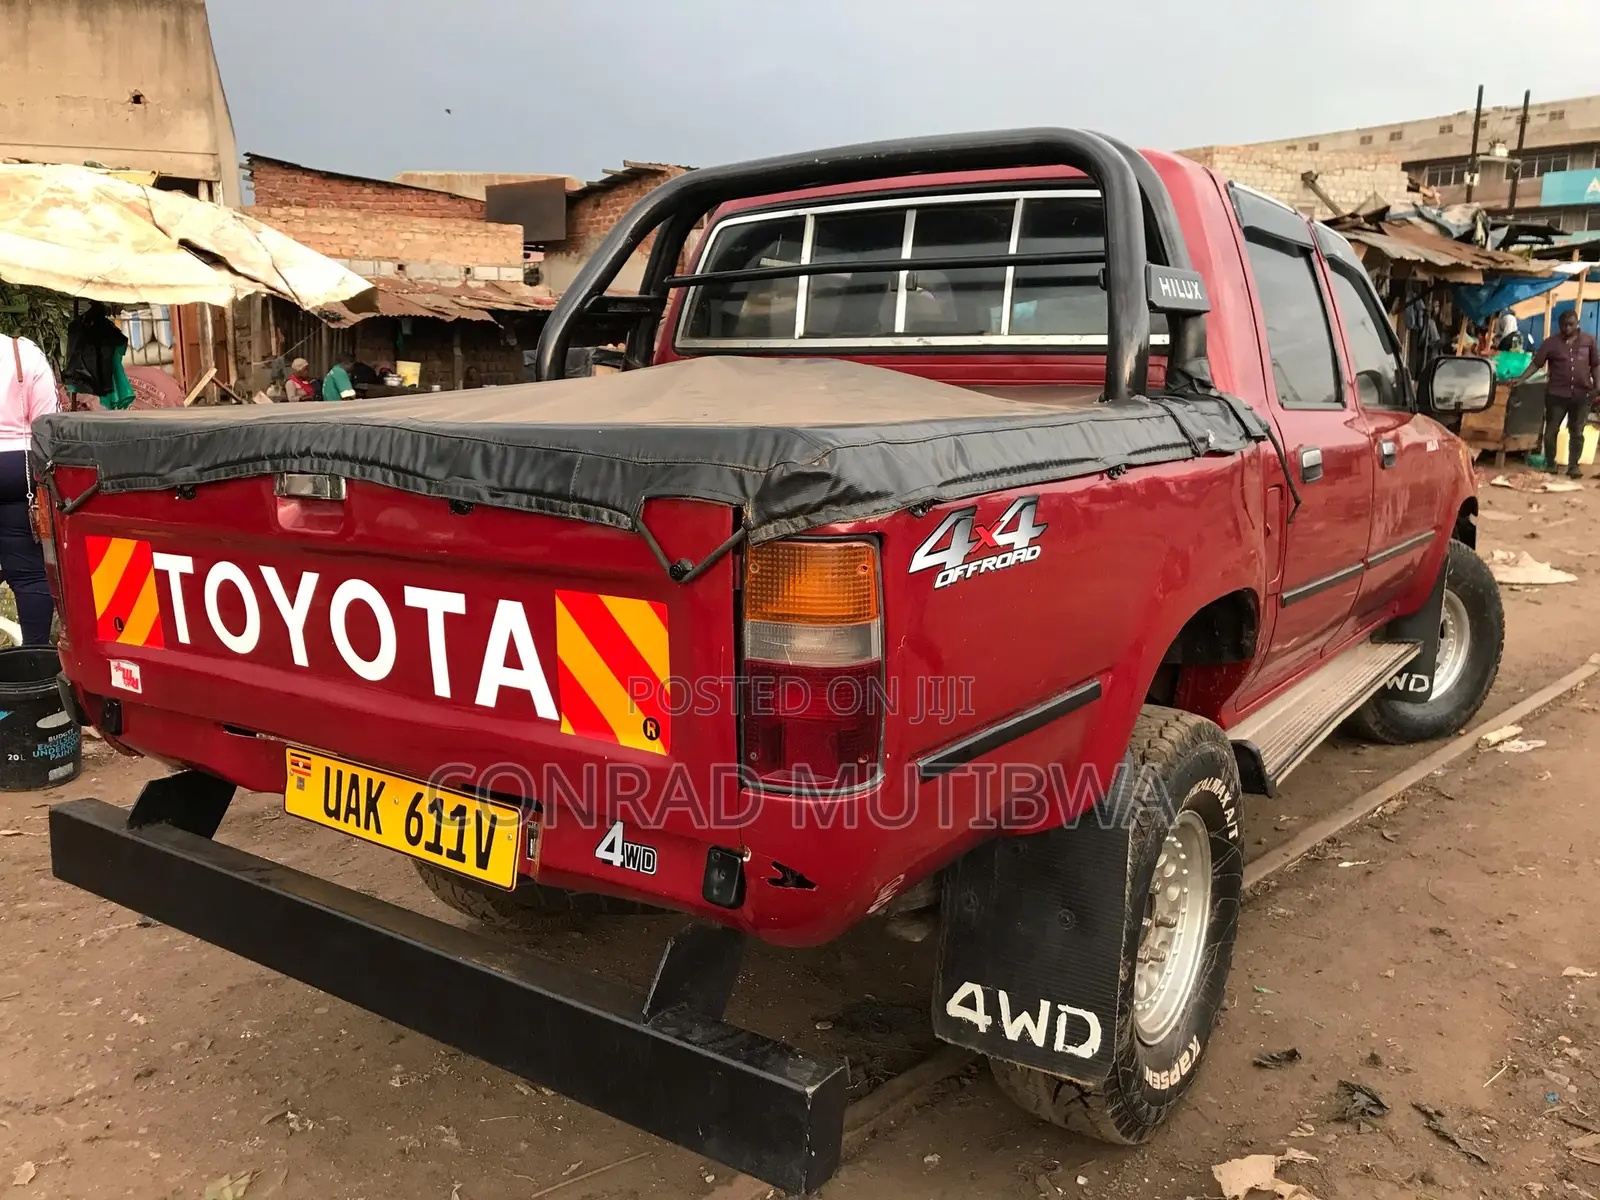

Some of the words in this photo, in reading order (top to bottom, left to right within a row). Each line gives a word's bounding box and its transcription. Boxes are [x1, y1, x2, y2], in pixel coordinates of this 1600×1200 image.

[1158, 277, 1203, 300] HILUX
[934, 545, 1041, 589] OFFROAD
[153, 551, 560, 722] TOYOTA
[1385, 672, 1430, 692] WD
[646, 720, 657, 738] R
[49, 746, 74, 761] PAINT
[323, 766, 386, 835] UAK
[405, 791, 498, 870] 611V
[595, 820, 657, 875] 4WD
[946, 981, 1101, 1058] 4WD
